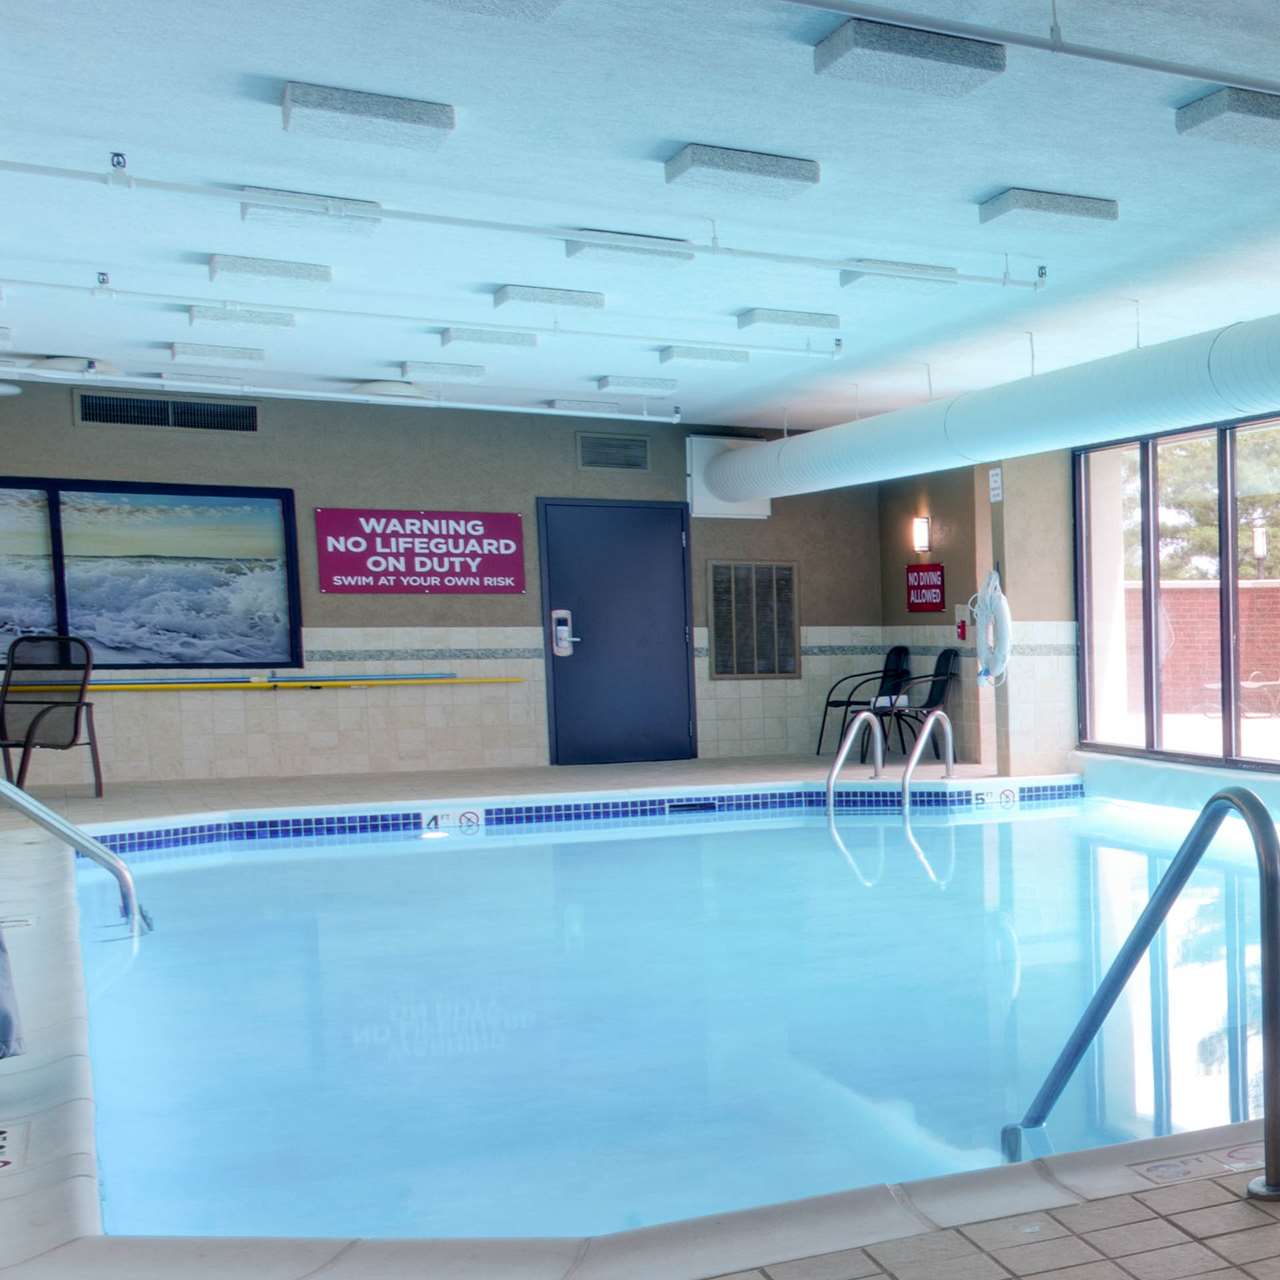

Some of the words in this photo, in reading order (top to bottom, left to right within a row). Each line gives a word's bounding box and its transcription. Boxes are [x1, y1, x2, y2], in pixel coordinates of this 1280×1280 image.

[358, 517, 485, 536] WARNING
[326, 536, 368, 552] NO
[375, 537, 517, 554] LIFEGUARD
[366, 556, 406, 572] ON
[414, 556, 483, 573] DUTY
[332, 575, 374, 586] SWIM
[378, 576, 396, 586] AT
[400, 576, 441, 586] YOUR
[444, 576, 480, 587] OWN
[483, 577, 515, 587] RISK
[908, 571, 919, 586] NO
[919, 571, 942, 586] DIVING
[910, 588, 941, 604] ALLOWED
